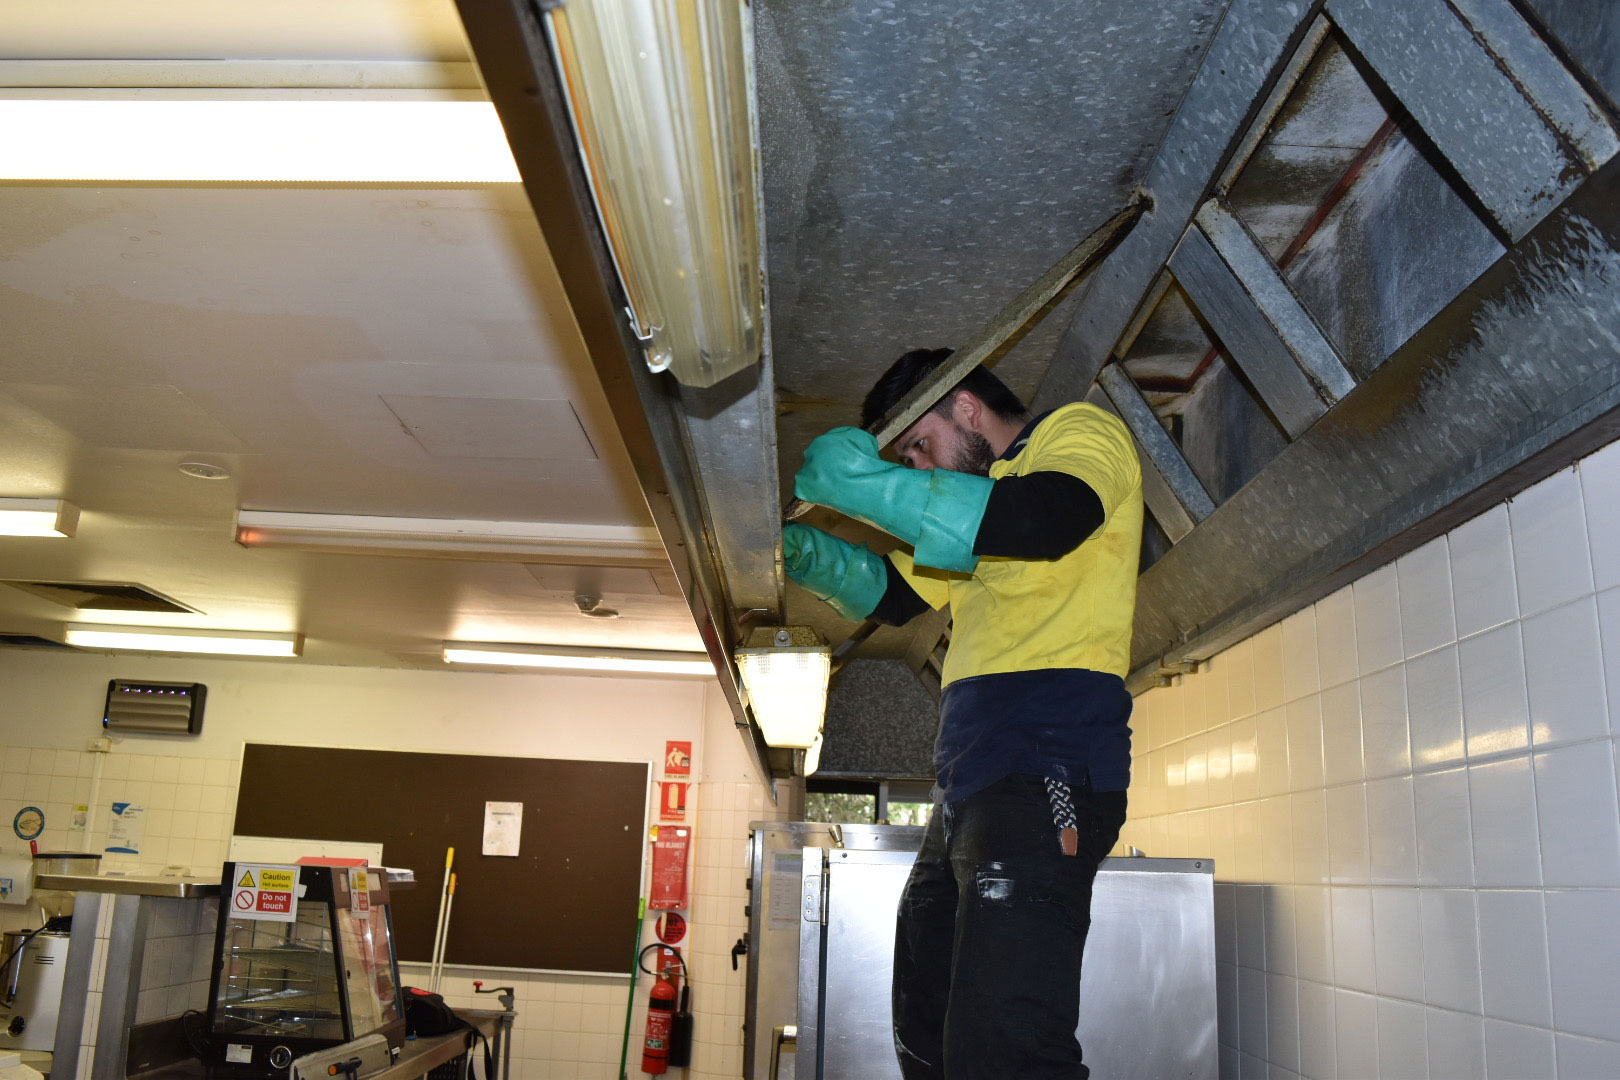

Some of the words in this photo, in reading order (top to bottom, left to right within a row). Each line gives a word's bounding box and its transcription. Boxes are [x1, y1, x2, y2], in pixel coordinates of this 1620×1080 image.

[262, 872, 291, 881] Caution
[274, 894, 287, 902] not
[262, 902, 284, 910] touch
